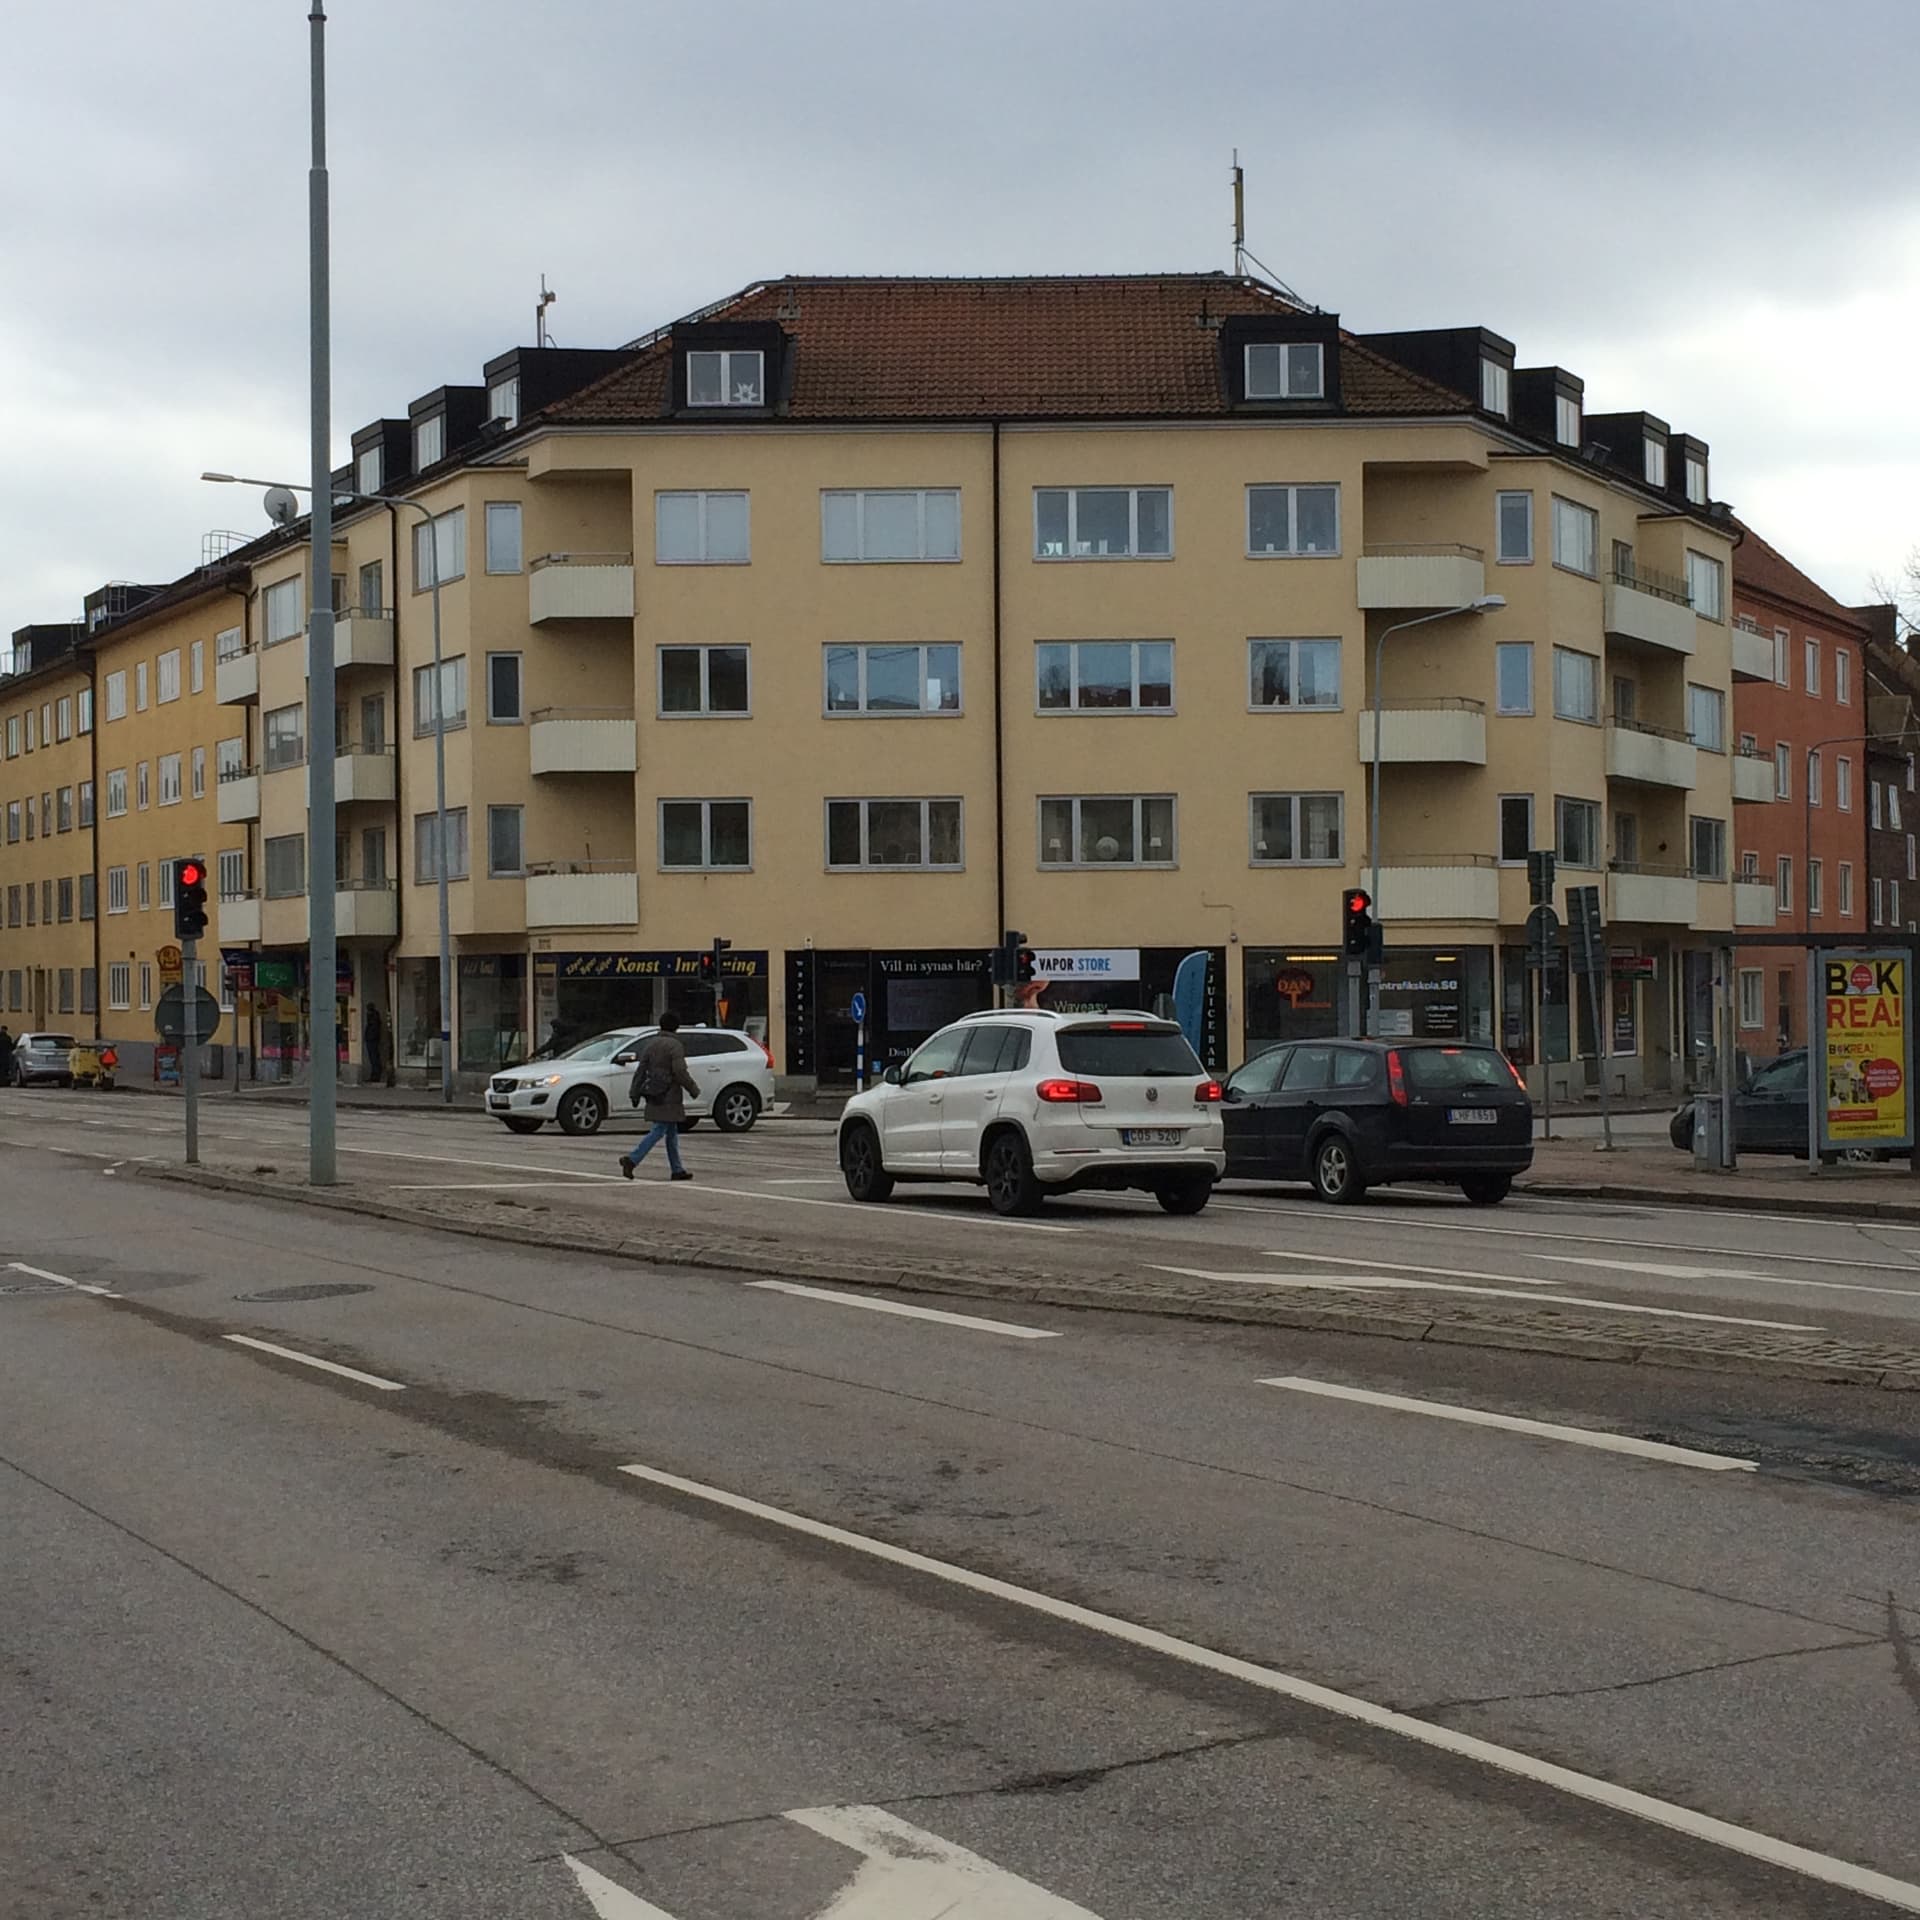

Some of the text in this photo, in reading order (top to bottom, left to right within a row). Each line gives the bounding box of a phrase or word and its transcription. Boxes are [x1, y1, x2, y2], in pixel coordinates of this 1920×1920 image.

[615, 956, 660, 973] Konst
[675, 956, 756, 975] Inring
[880, 960, 902, 972] Vill
[906, 960, 917, 972] ni
[921, 963, 953, 976] synas
[957, 960, 983, 972] här?
[1039, 957, 1112, 971] VAPOR STORE
[1278, 979, 1311, 993] DAN
[1826, 997, 1901, 1028] REA!
